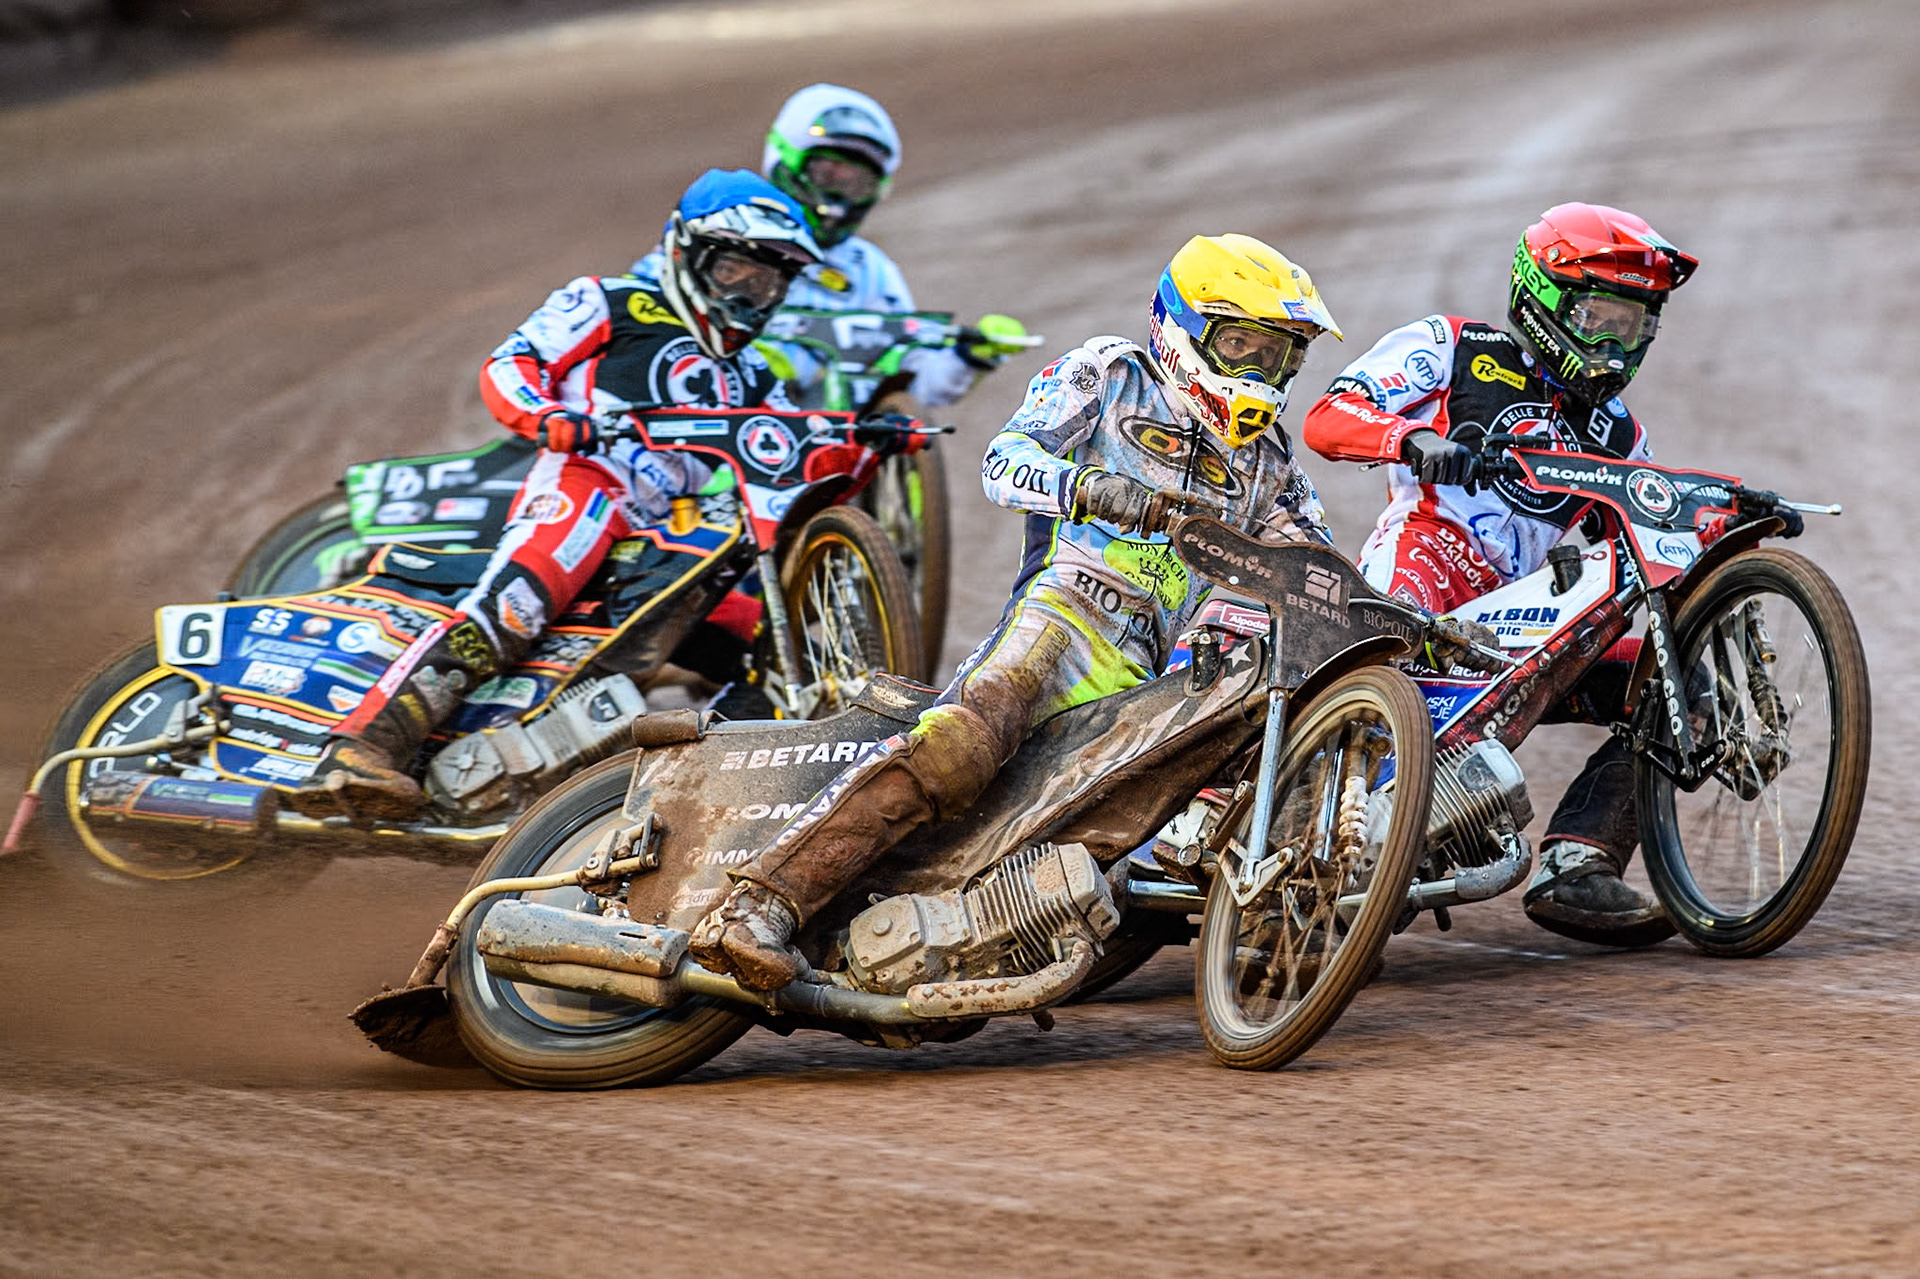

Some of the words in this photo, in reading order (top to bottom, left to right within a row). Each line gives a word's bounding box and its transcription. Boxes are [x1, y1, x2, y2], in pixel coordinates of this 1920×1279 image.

[1521, 306, 1561, 356] MONSTER
[1411, 355, 1436, 387] ATPI
[1501, 407, 1534, 428] BELLE
[1012, 463, 1051, 497] OIL
[1074, 570, 1121, 614] BIO
[1286, 593, 1352, 629] BETARD
[178, 612, 213, 659] 6
[1495, 626, 1521, 636] plc
